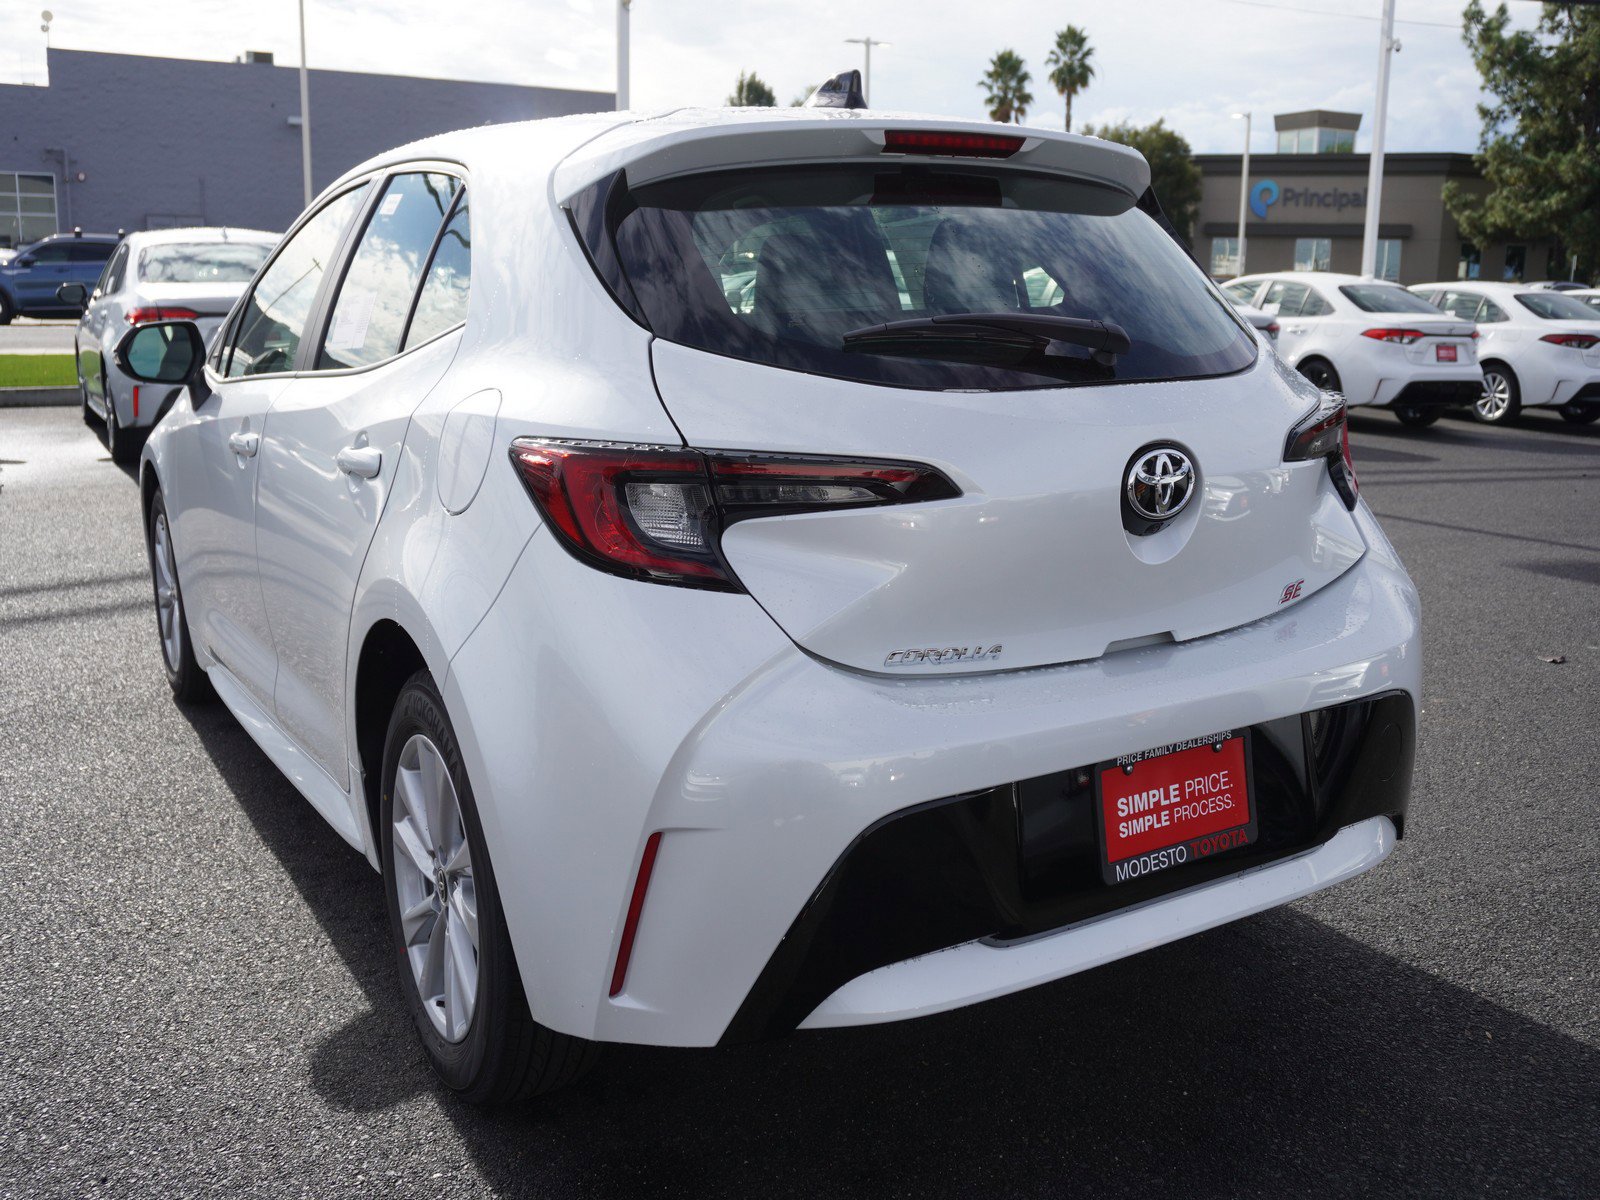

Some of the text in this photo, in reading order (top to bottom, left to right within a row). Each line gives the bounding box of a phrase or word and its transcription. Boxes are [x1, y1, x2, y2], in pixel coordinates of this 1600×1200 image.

[1282, 187, 1368, 212] Principal
[1278, 578, 1304, 604] SE
[884, 644, 1002, 667] COROLLA
[1117, 731, 1232, 766] PRICE FAMILY DEALERSHIPS
[1117, 770, 1233, 818] SIMPLE PRICE.
[1118, 793, 1235, 838] SIMPLE PROCESS.
[1115, 829, 1249, 882] MODESTO TOYOTA
